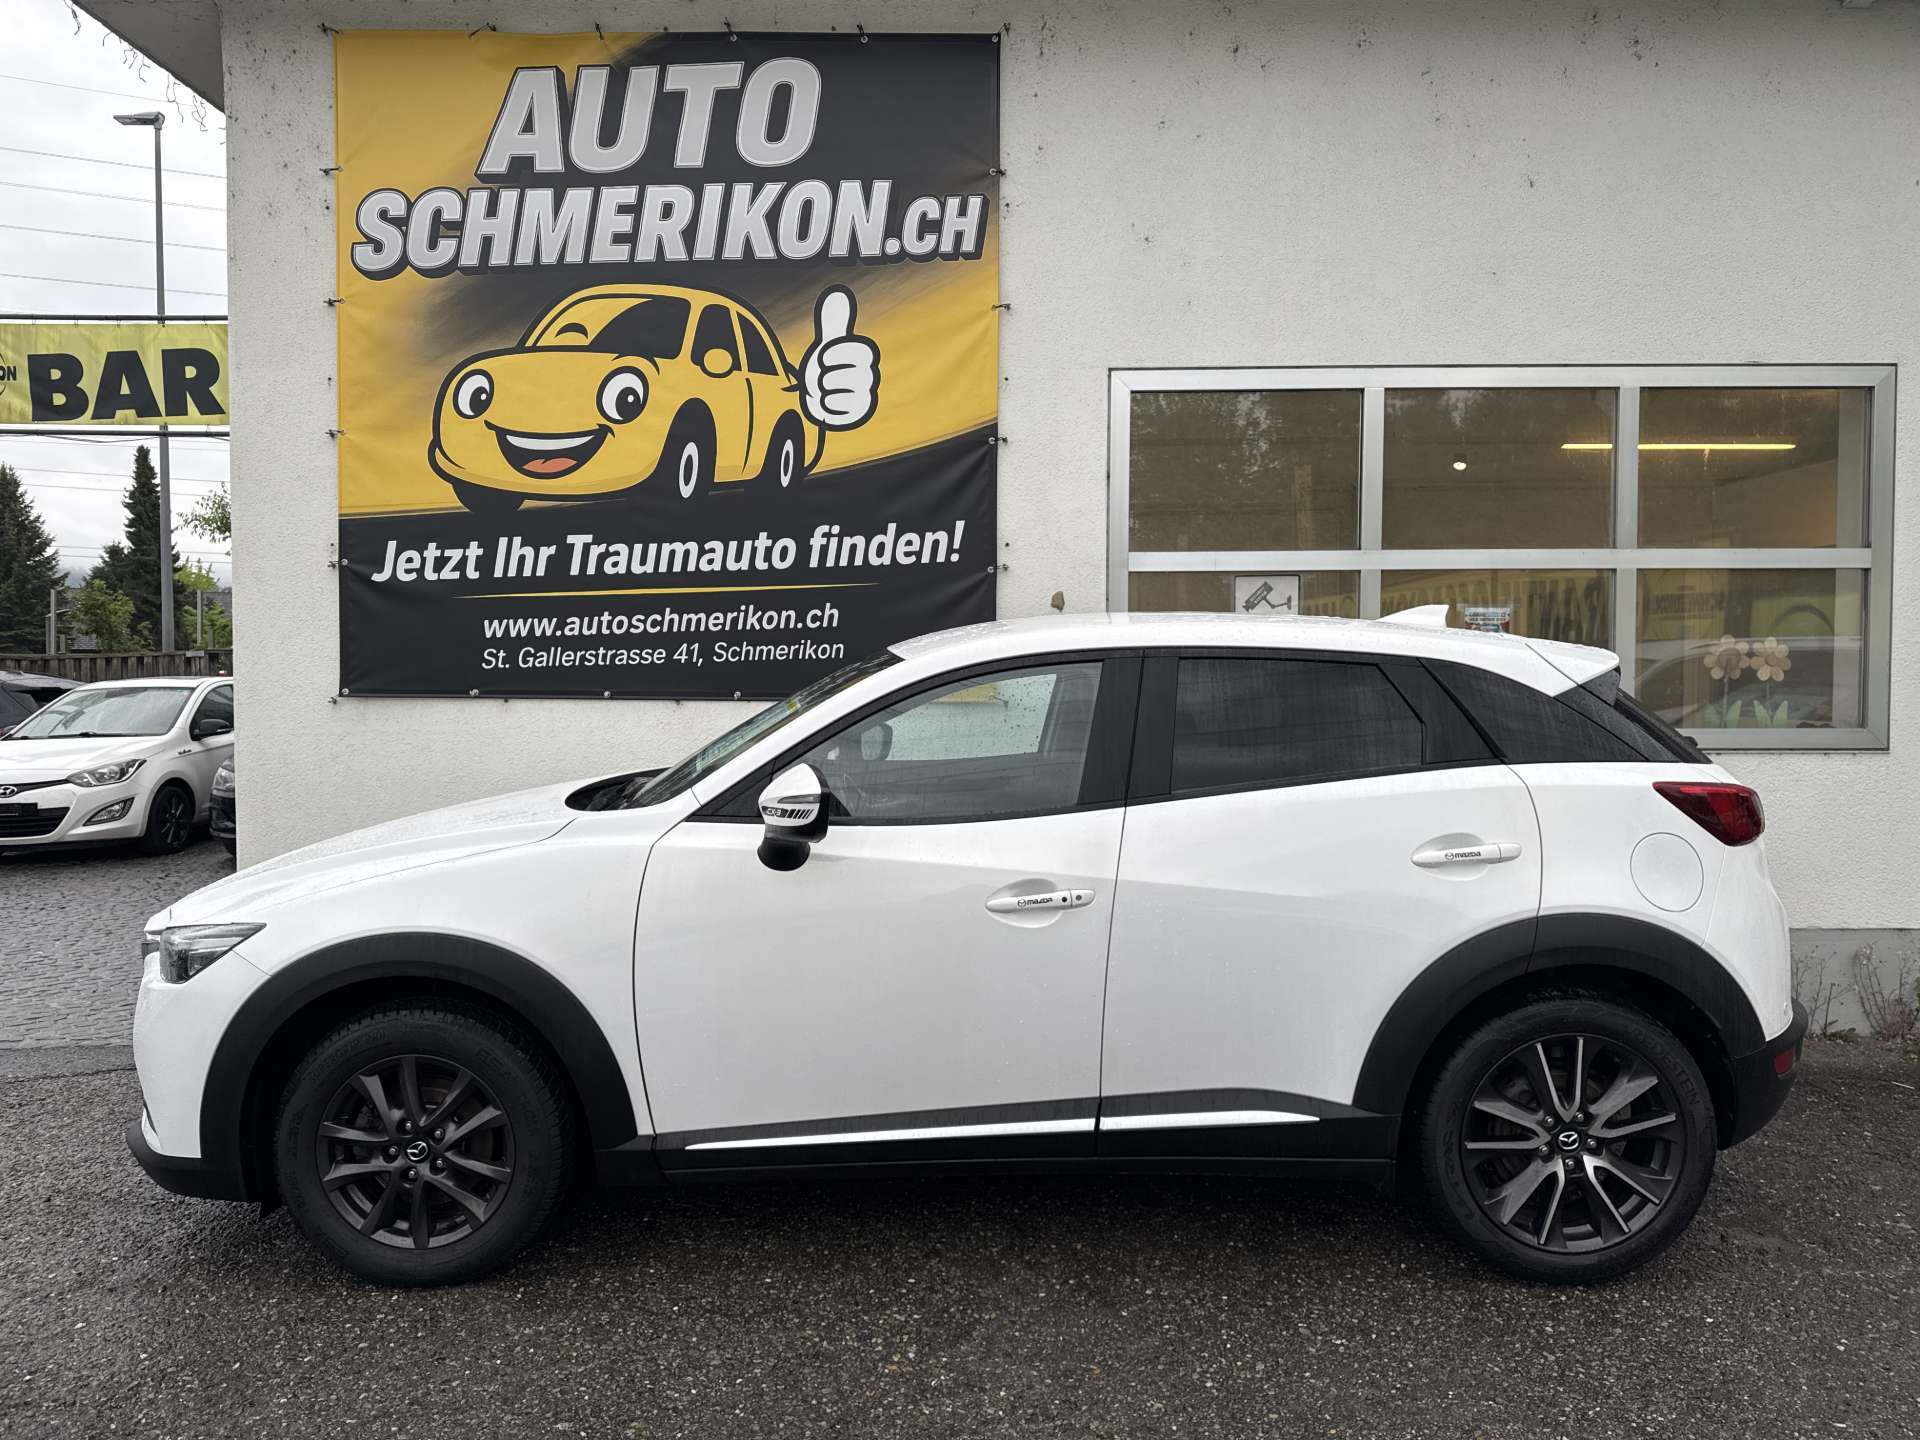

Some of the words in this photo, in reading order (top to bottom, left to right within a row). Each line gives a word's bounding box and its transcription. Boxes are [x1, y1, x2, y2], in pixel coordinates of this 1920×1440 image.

[476, 57, 822, 175] AUTO
[353, 179, 984, 272] SCHMERIKON.CH
[28, 347, 226, 421] BAR
[371, 541, 483, 582] Jetzt
[493, 535, 556, 578] Ihr
[566, 530, 797, 576] Traumauto
[808, 519, 966, 568] finden!
[481, 647, 510, 670] St.
[518, 647, 667, 668] Gallerstrasse
[673, 642, 703, 667] 41,
[713, 640, 845, 663] Schmerikon
[483, 603, 839, 639] www.autoschmerikon.ch
